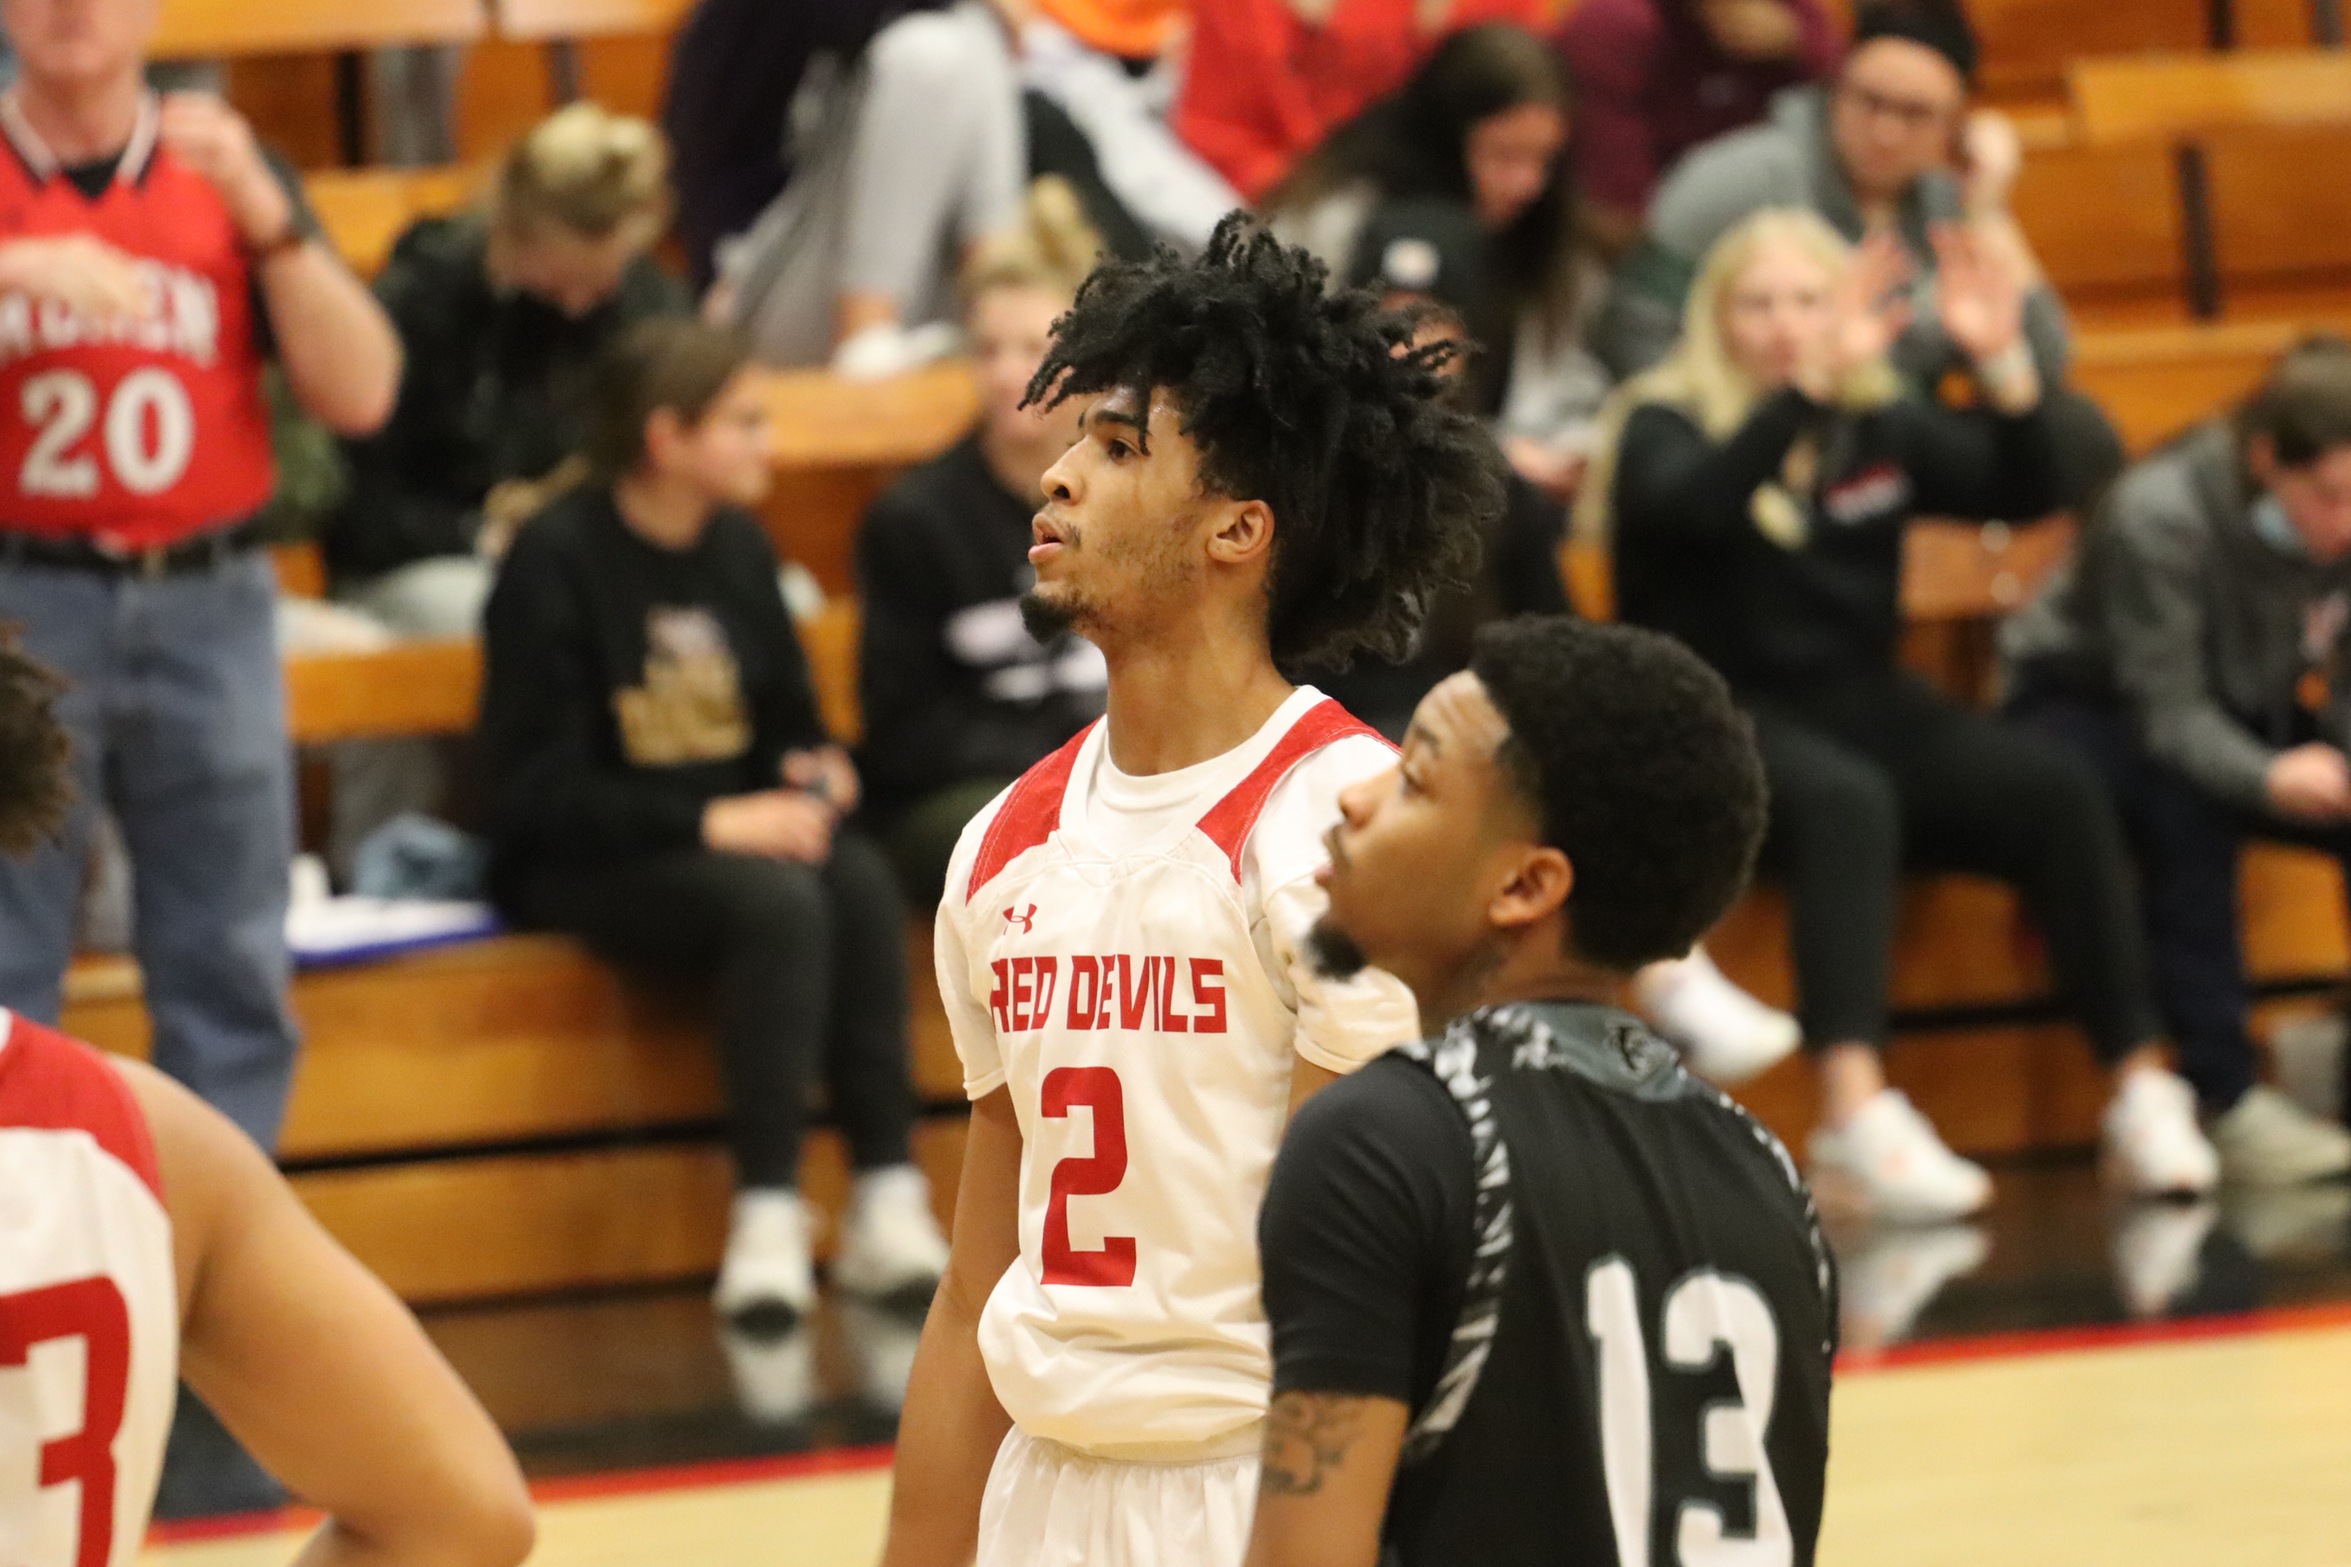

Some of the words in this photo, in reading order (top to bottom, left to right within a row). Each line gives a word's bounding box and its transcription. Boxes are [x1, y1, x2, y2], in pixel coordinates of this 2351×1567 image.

[20, 367, 196, 495] 20
[990, 956, 1057, 1033] RED
[1067, 954, 1227, 1033] DEVILS
[1040, 1067, 1137, 1287] 2
[1586, 1257, 1794, 1567] 13
